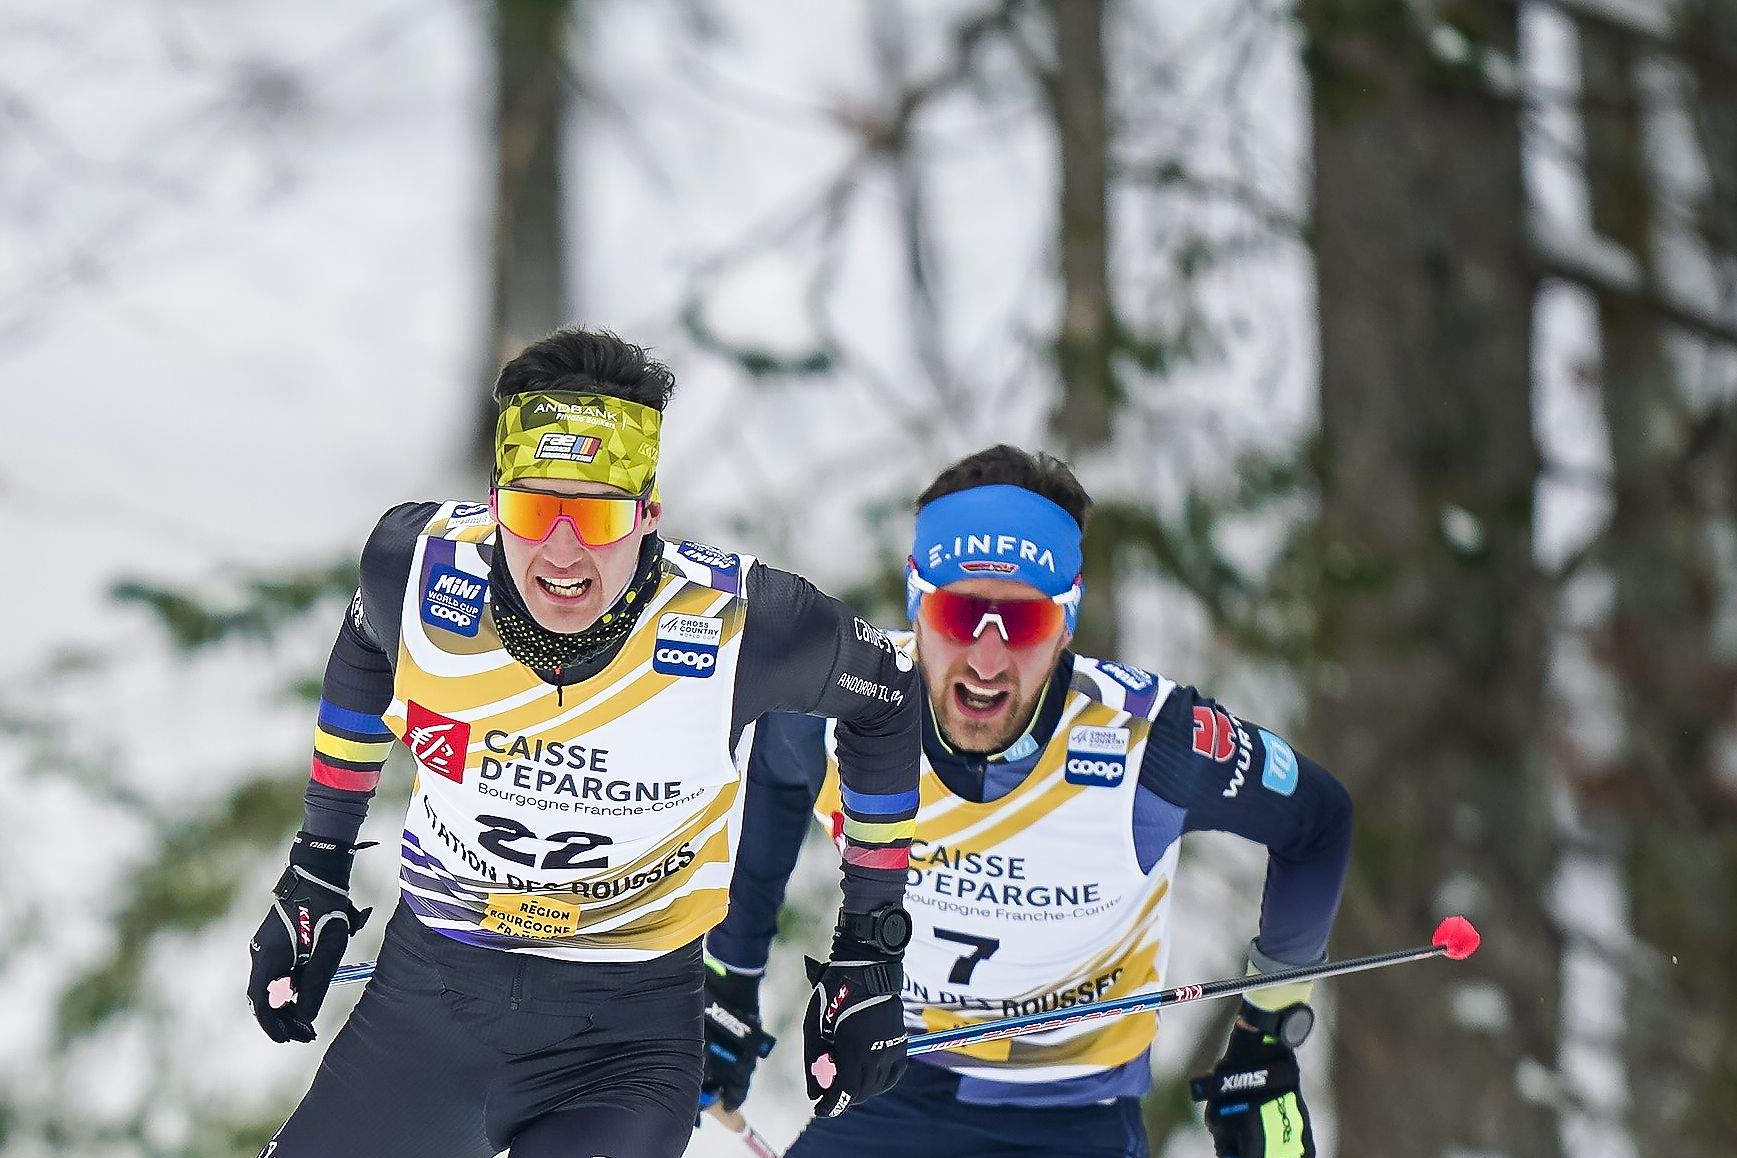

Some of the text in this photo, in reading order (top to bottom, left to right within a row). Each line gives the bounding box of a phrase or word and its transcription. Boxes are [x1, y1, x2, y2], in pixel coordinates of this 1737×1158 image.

[533, 402, 617, 422] ANDBANK
[928, 534, 1055, 573] E.INFRA
[428, 590, 479, 614] WORLD CUP
[430, 604, 472, 627] coop
[679, 626, 720, 636] COUNTRY
[680, 619, 709, 629] CROSS
[656, 648, 715, 670] coop
[837, 672, 879, 698] ANDORRA
[484, 729, 609, 773] CAISSE
[480, 756, 682, 802] D'EPARGNE
[1067, 758, 1124, 780] coop
[478, 782, 570, 811] Bourgogne
[475, 814, 613, 870] 22
[571, 841, 696, 899] ROUSSES
[909, 838, 1026, 880] CAISSE
[933, 926, 1000, 985] 7
